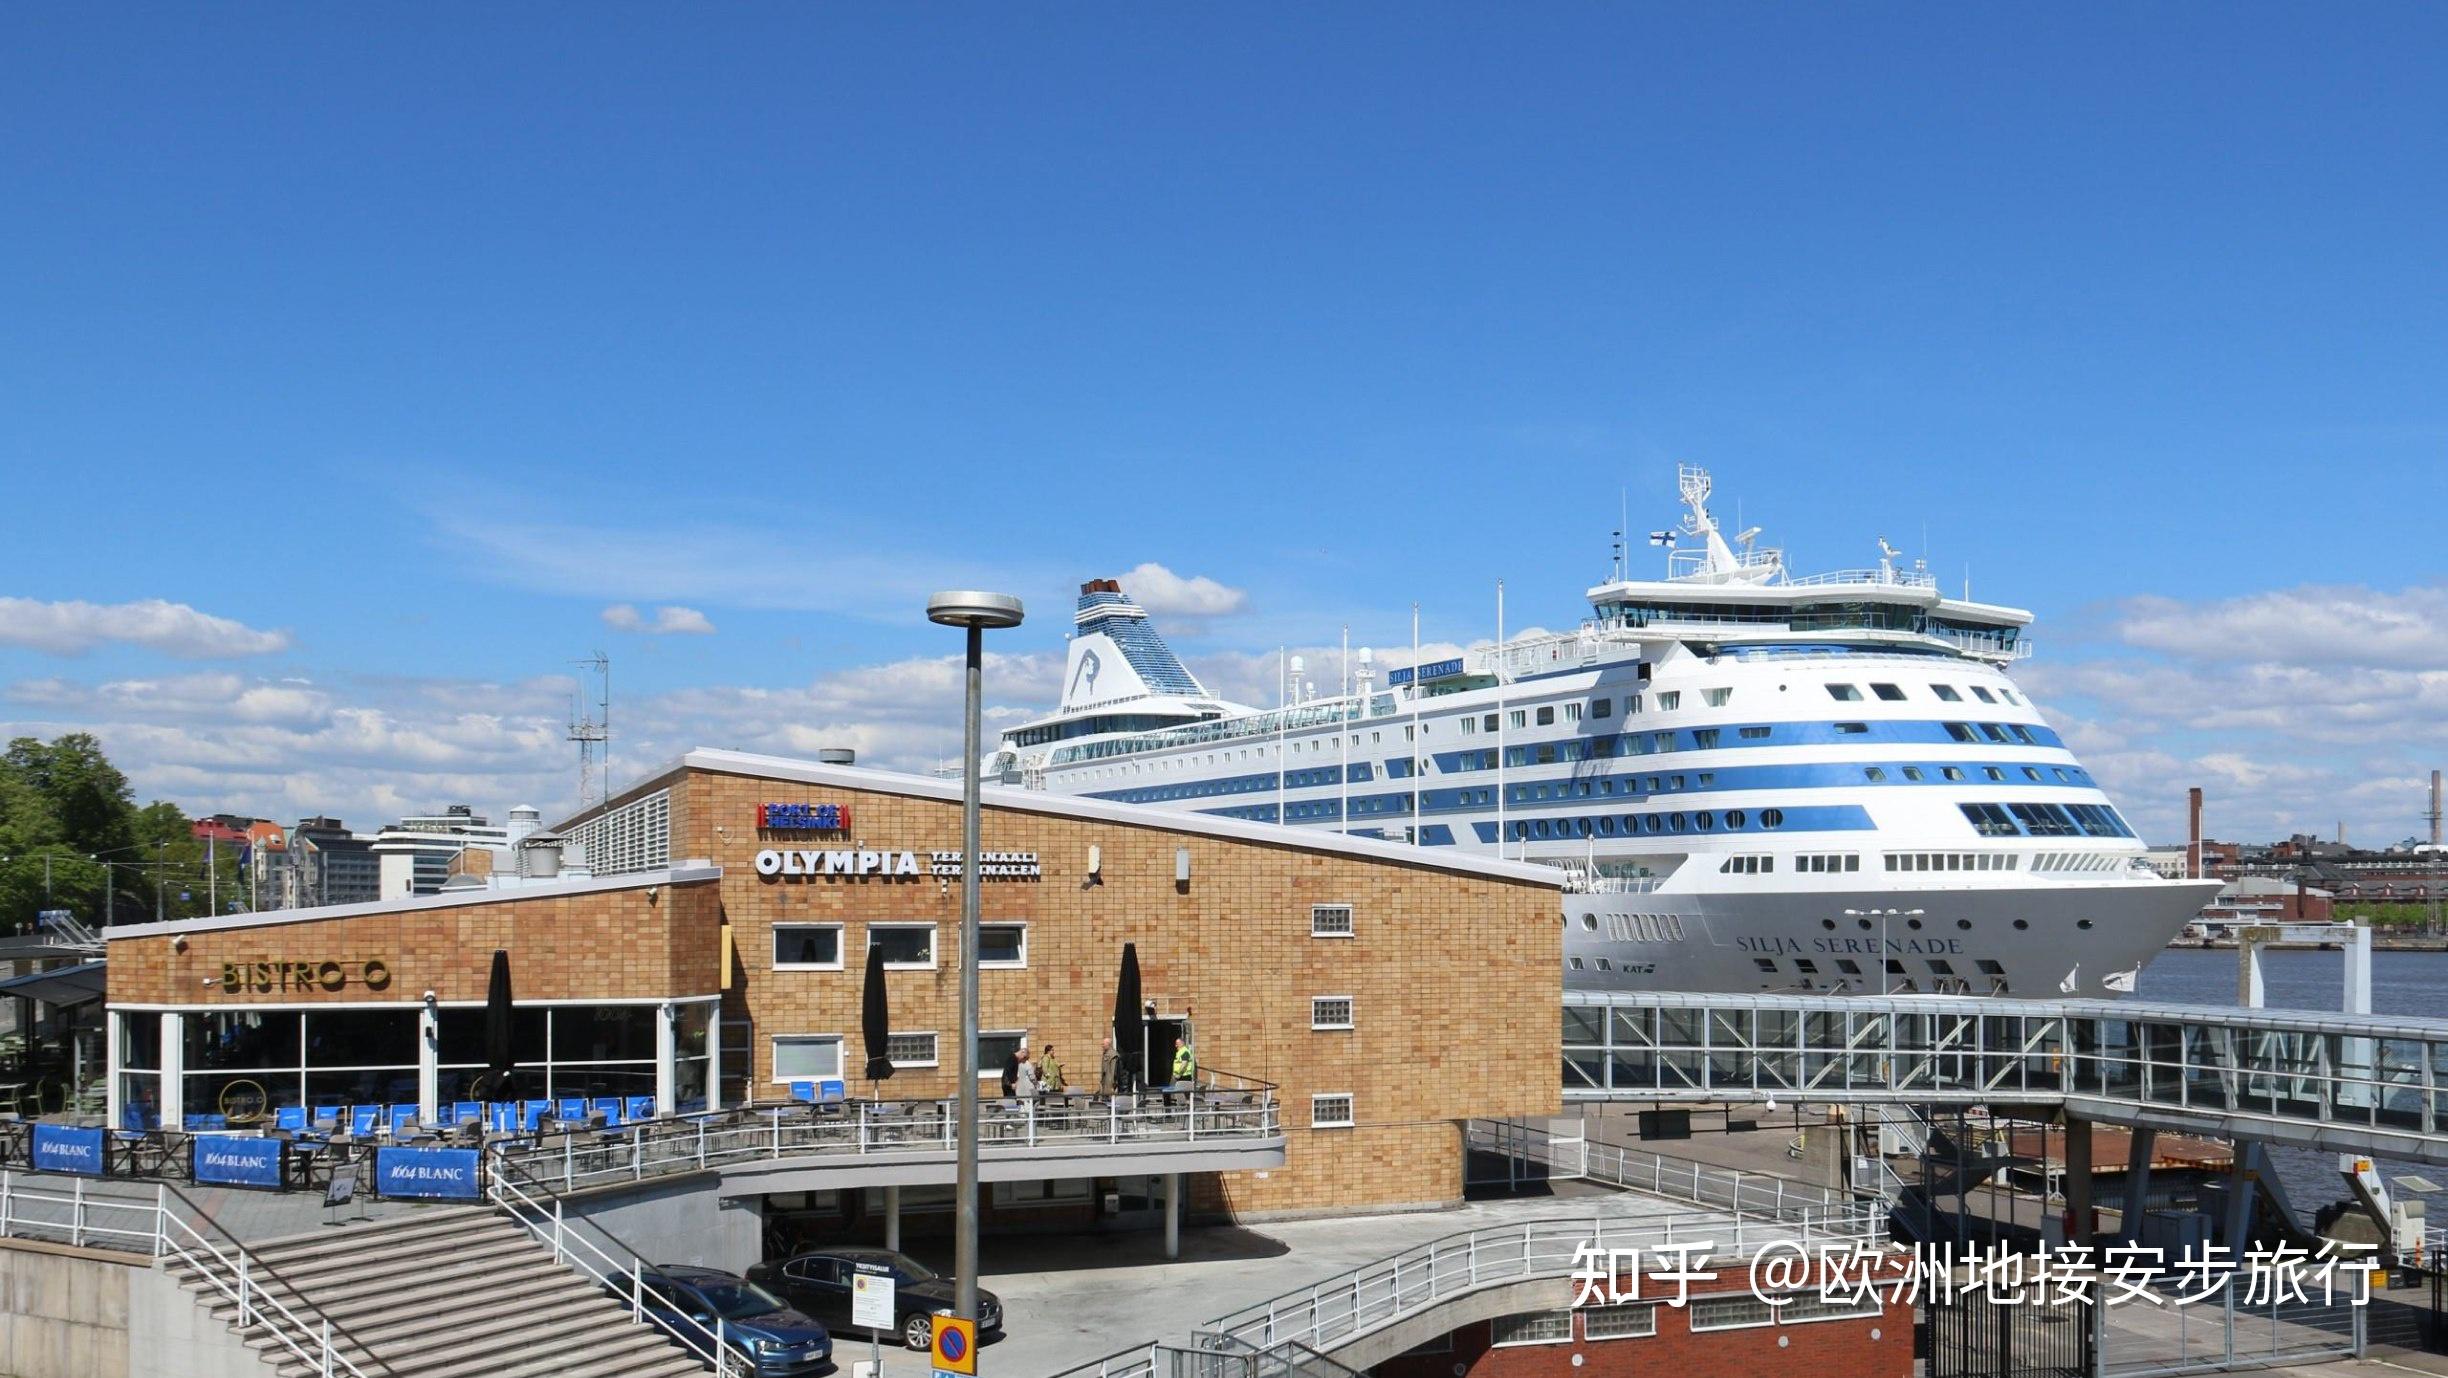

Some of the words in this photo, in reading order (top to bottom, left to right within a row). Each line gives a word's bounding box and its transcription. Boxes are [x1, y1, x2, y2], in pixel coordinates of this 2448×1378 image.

[768, 816, 839, 829] HELSINKI
[755, 850, 919, 875] OLYMPIA
[931, 851, 1038, 863] TERINAALI
[931, 864, 1041, 876] TERINALEN
[1737, 936, 1802, 956] SILJA
[1813, 937, 1964, 955] SERENADE
[222, 960, 345, 987] BISTRO
[363, 959, 390, 985] O
[60, 1143, 91, 1157] BLANC
[226, 1154, 267, 1169] BLANC
[391, 1165, 417, 1180] 1664
[418, 1167, 463, 1180] BLANC
